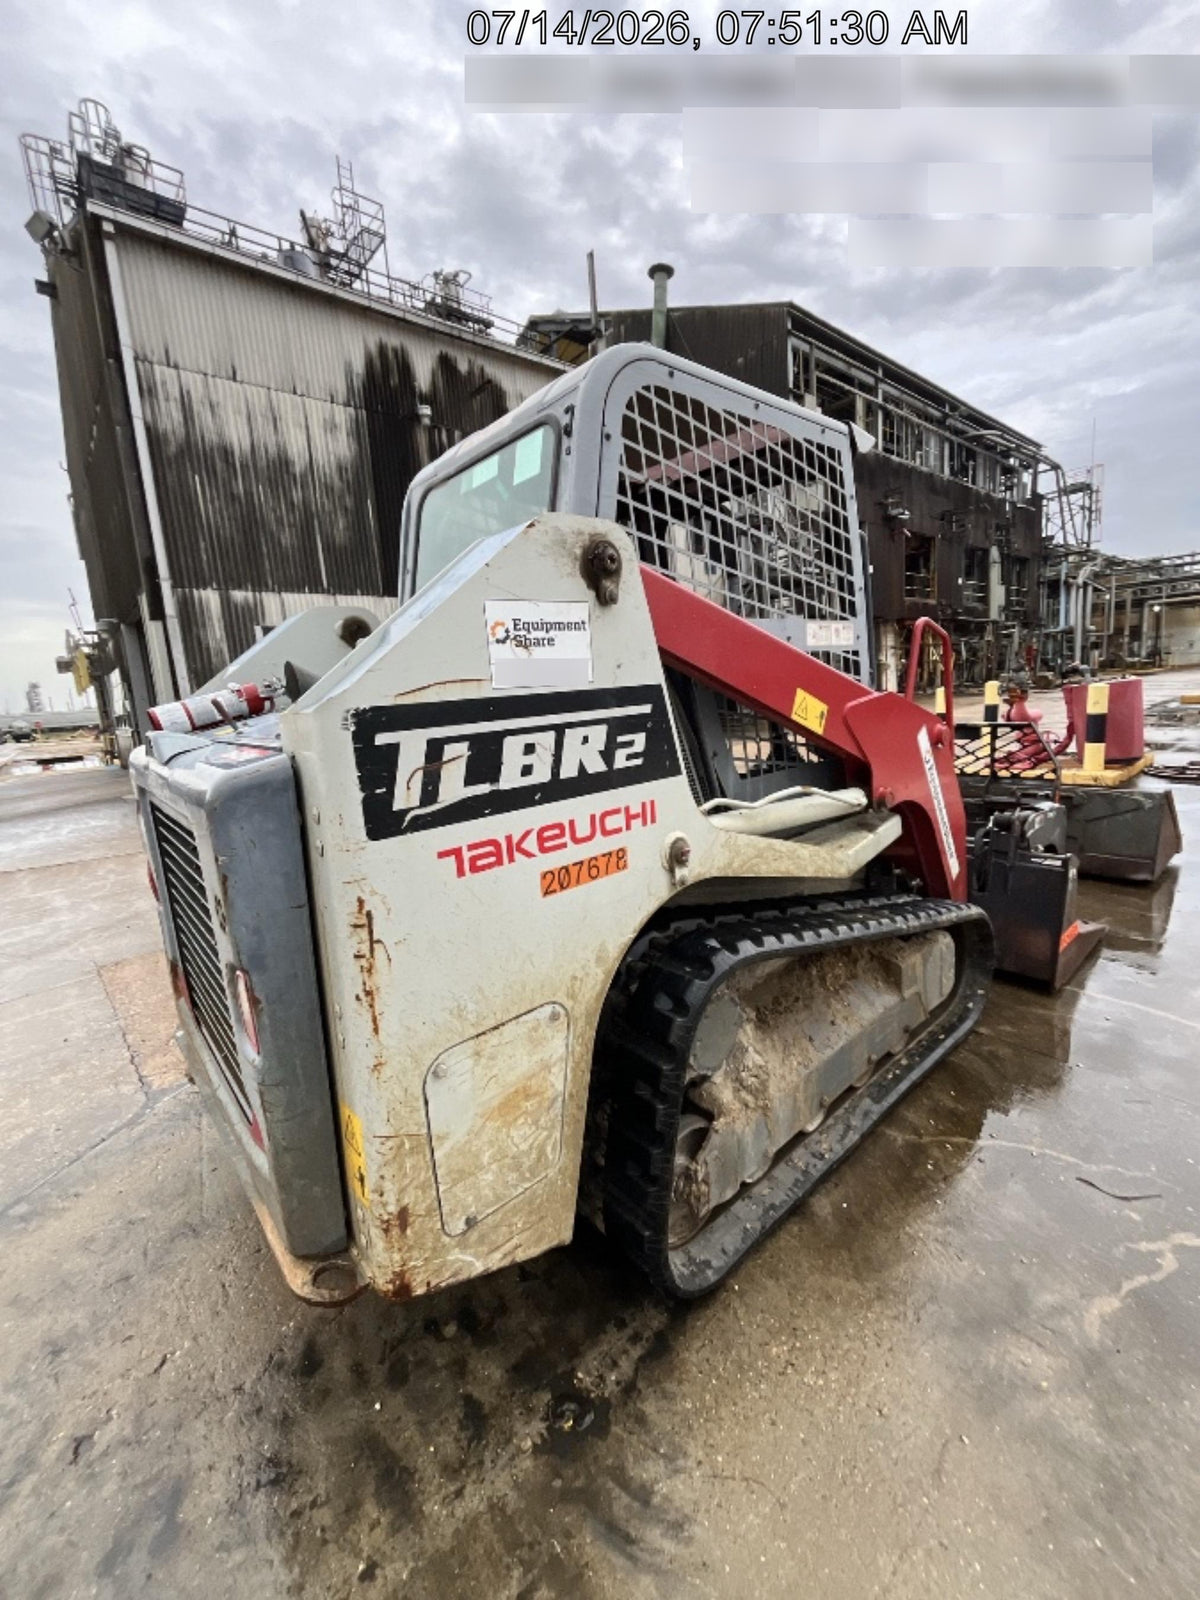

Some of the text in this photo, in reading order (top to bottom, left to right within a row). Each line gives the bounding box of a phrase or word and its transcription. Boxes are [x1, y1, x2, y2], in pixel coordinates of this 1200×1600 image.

[511, 618, 587, 634] Equipment
[513, 634, 556, 648] Share
[541, 847, 628, 898] 207678
